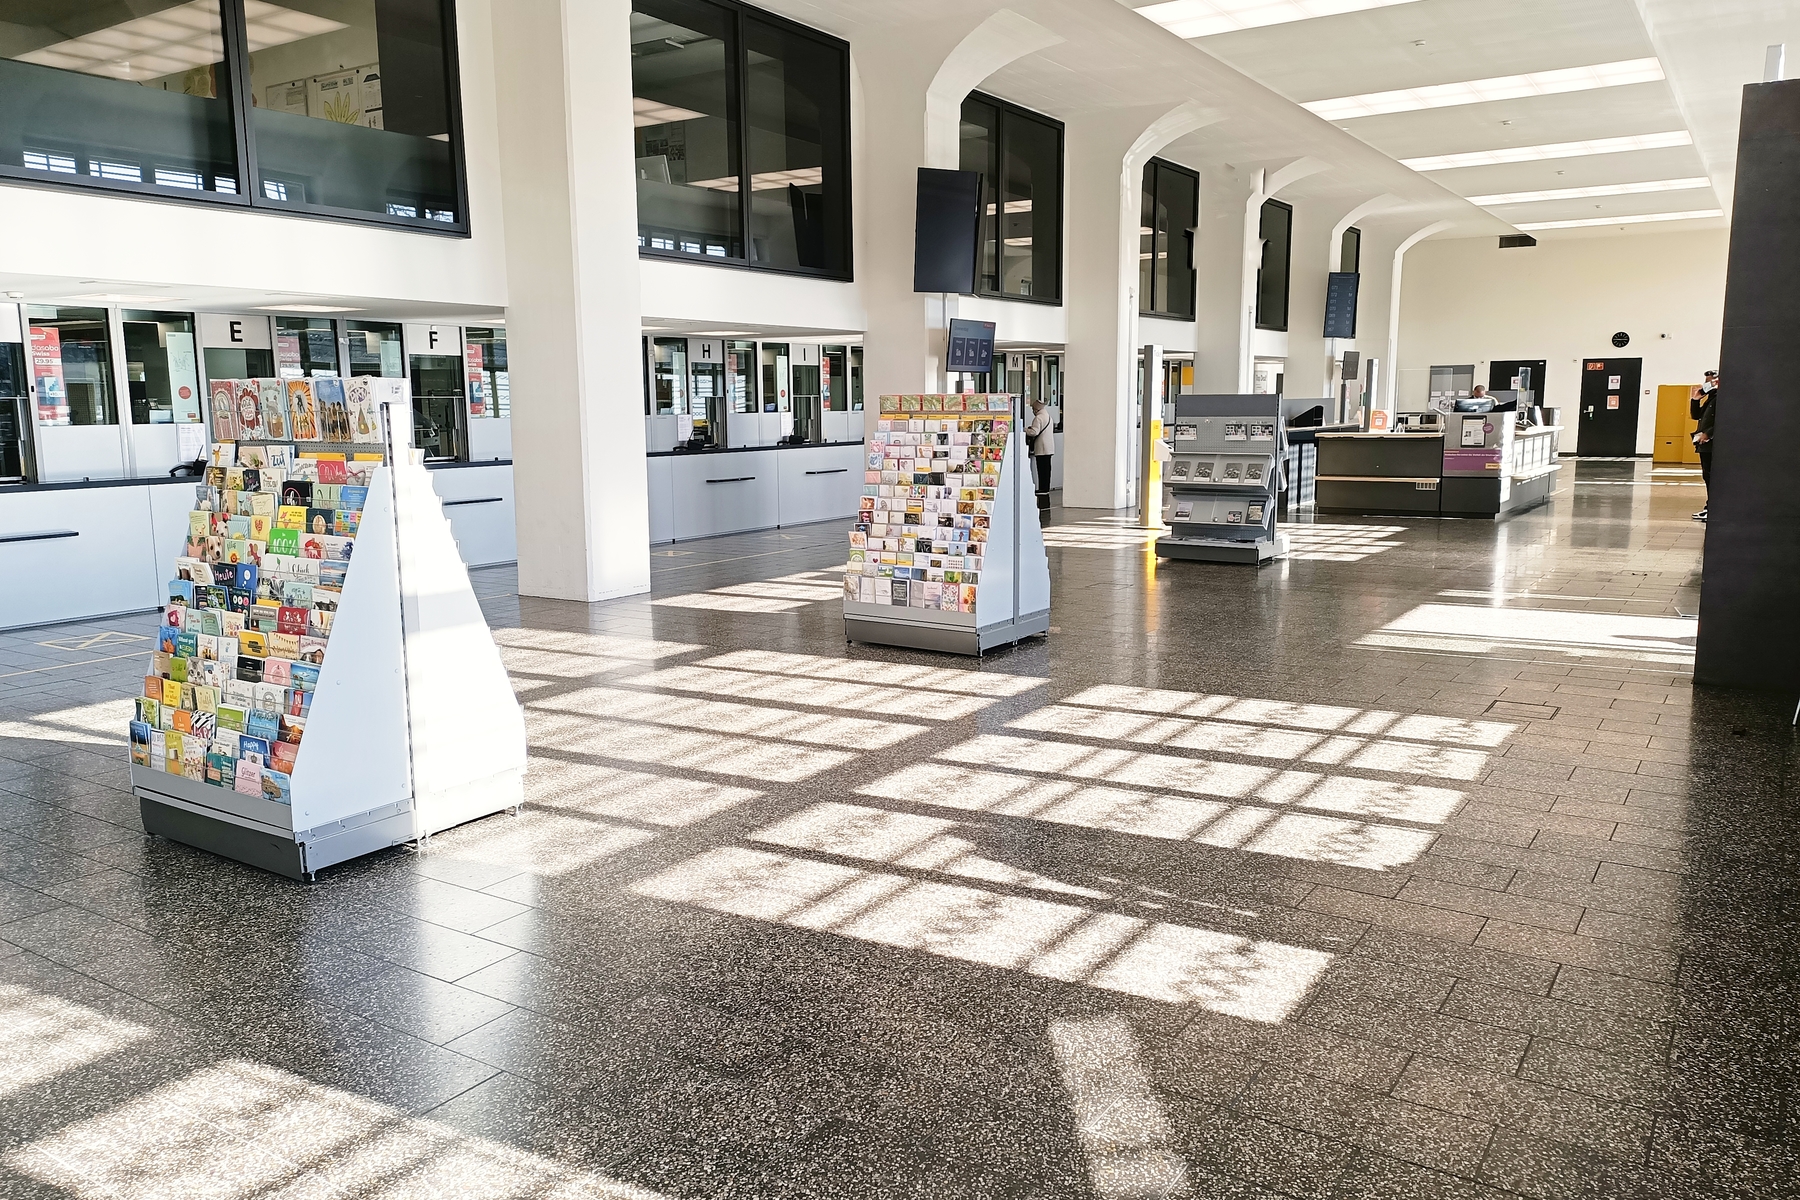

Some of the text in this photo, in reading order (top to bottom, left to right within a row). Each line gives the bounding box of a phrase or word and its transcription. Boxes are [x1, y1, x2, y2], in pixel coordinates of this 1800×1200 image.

[229, 320, 244, 343] E
[429, 331, 438, 350] F
[702, 343, 711, 359] H
[803, 347, 807, 362] I
[272, 538, 298, 555] 100%
[214, 568, 234, 581] Heute
[243, 740, 259, 751] Happy
